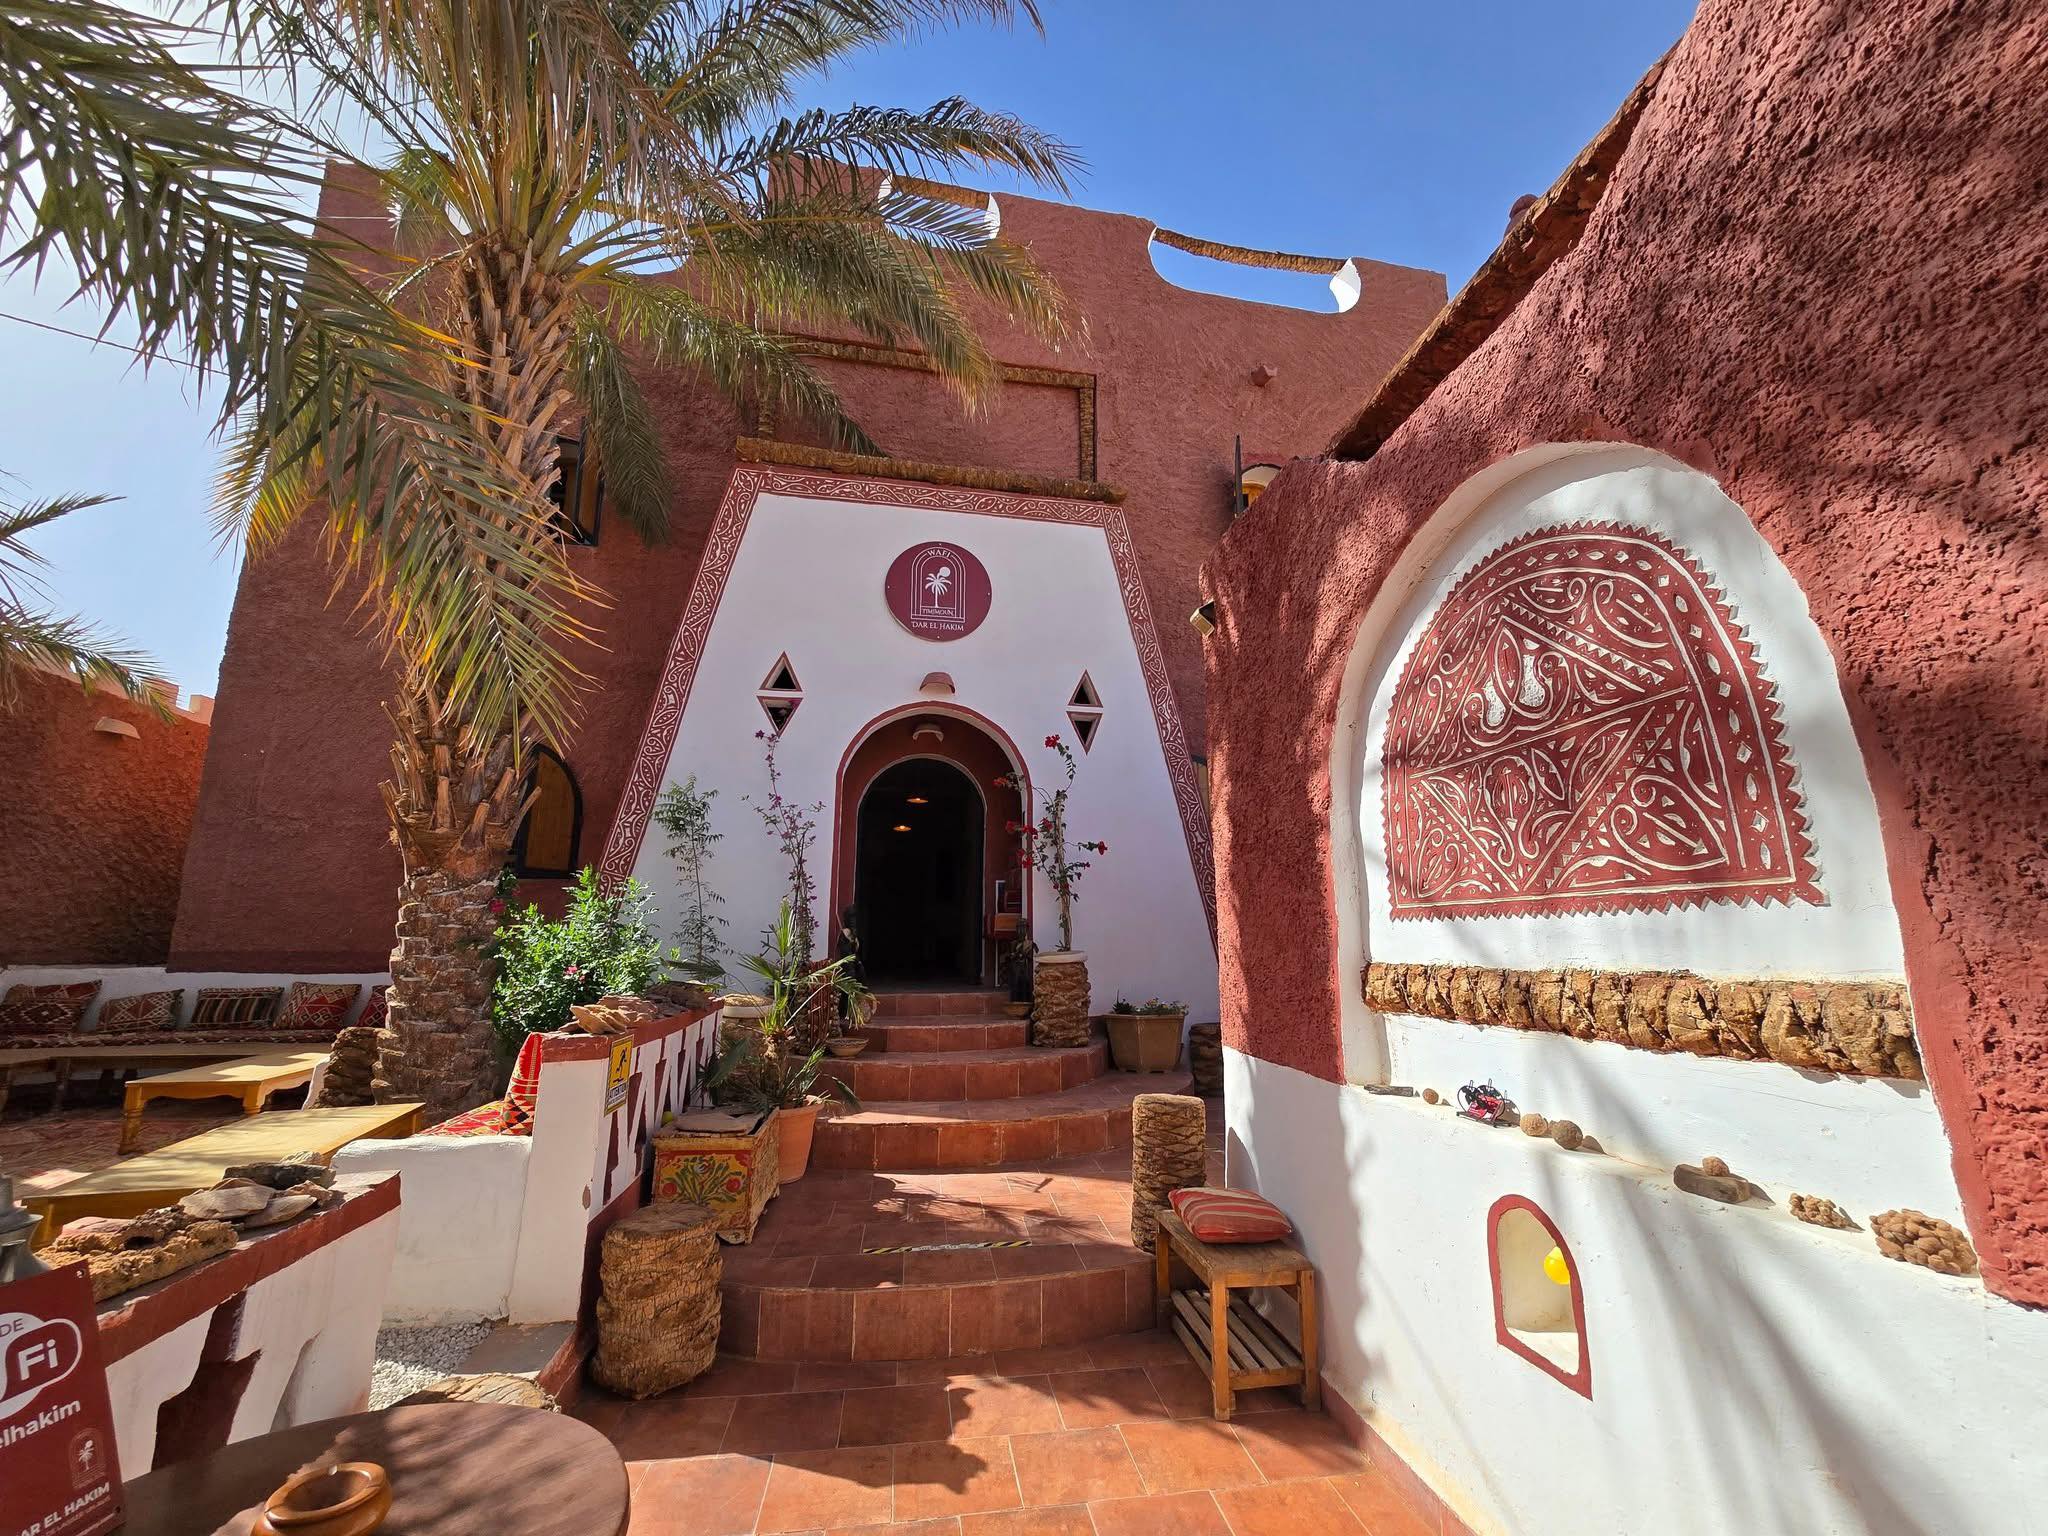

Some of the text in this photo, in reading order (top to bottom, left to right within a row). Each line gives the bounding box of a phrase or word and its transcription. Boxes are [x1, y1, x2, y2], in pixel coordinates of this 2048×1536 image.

[927, 549, 951, 558] WAFI
[18, 1339, 58, 1381] Fi
[44, 1511, 62, 1529] EL
[64, 1481, 110, 1517] HAKIM
